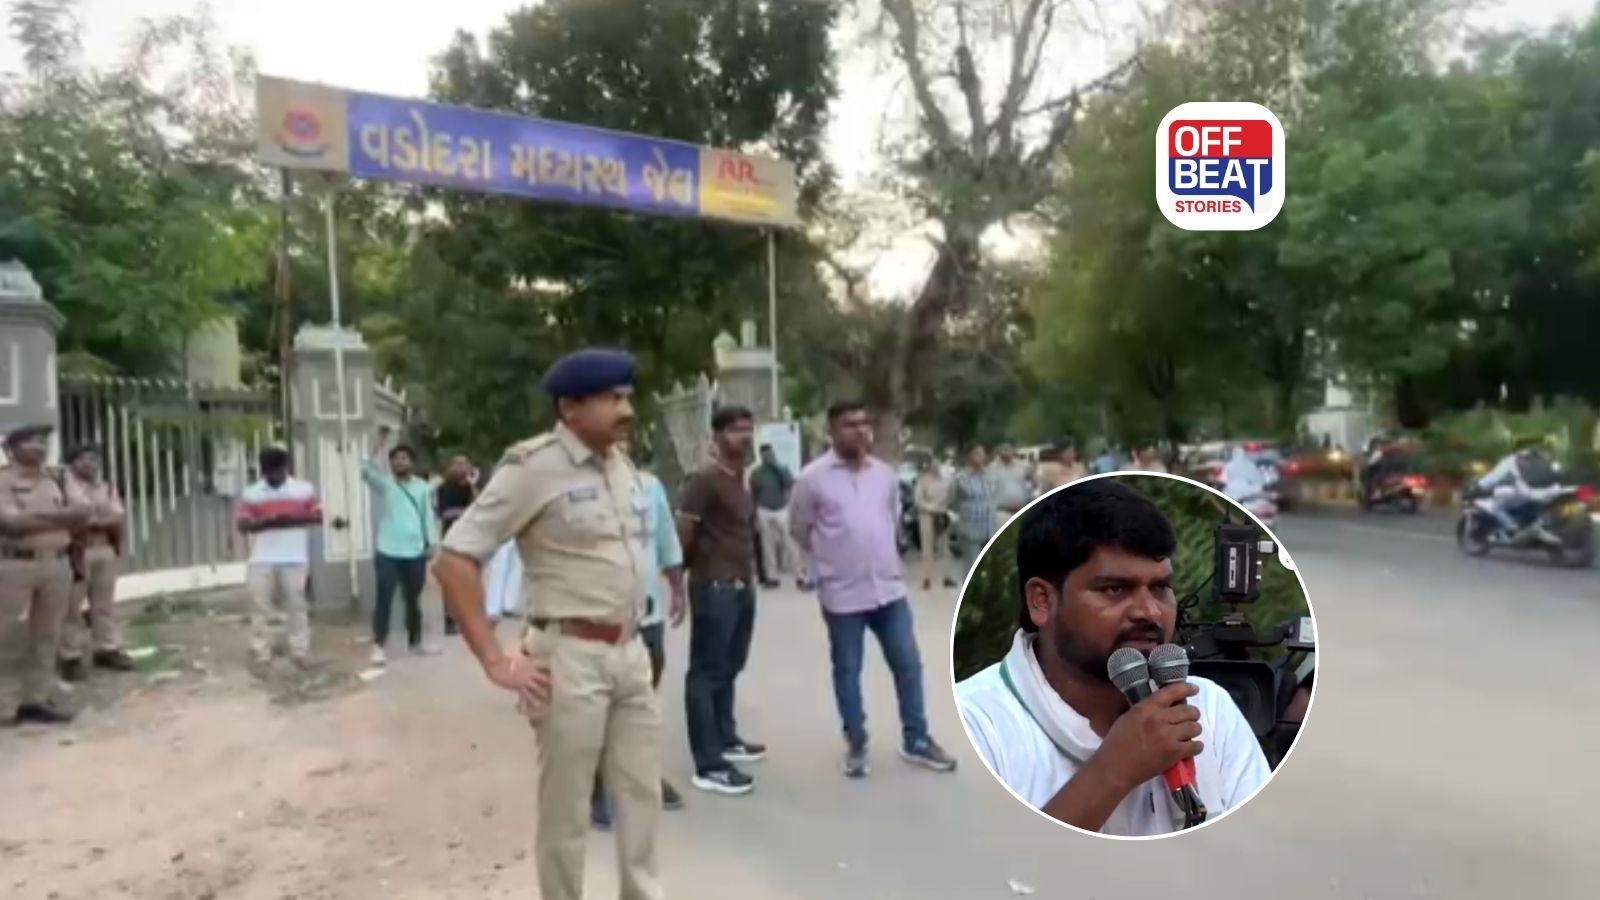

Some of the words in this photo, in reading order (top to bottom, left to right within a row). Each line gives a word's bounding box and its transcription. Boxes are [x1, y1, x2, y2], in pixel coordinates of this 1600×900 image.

[360, 108, 492, 180] વડોદરા
[510, 143, 628, 198] મધ્યસ્થ
[642, 146, 694, 206] જેલ
